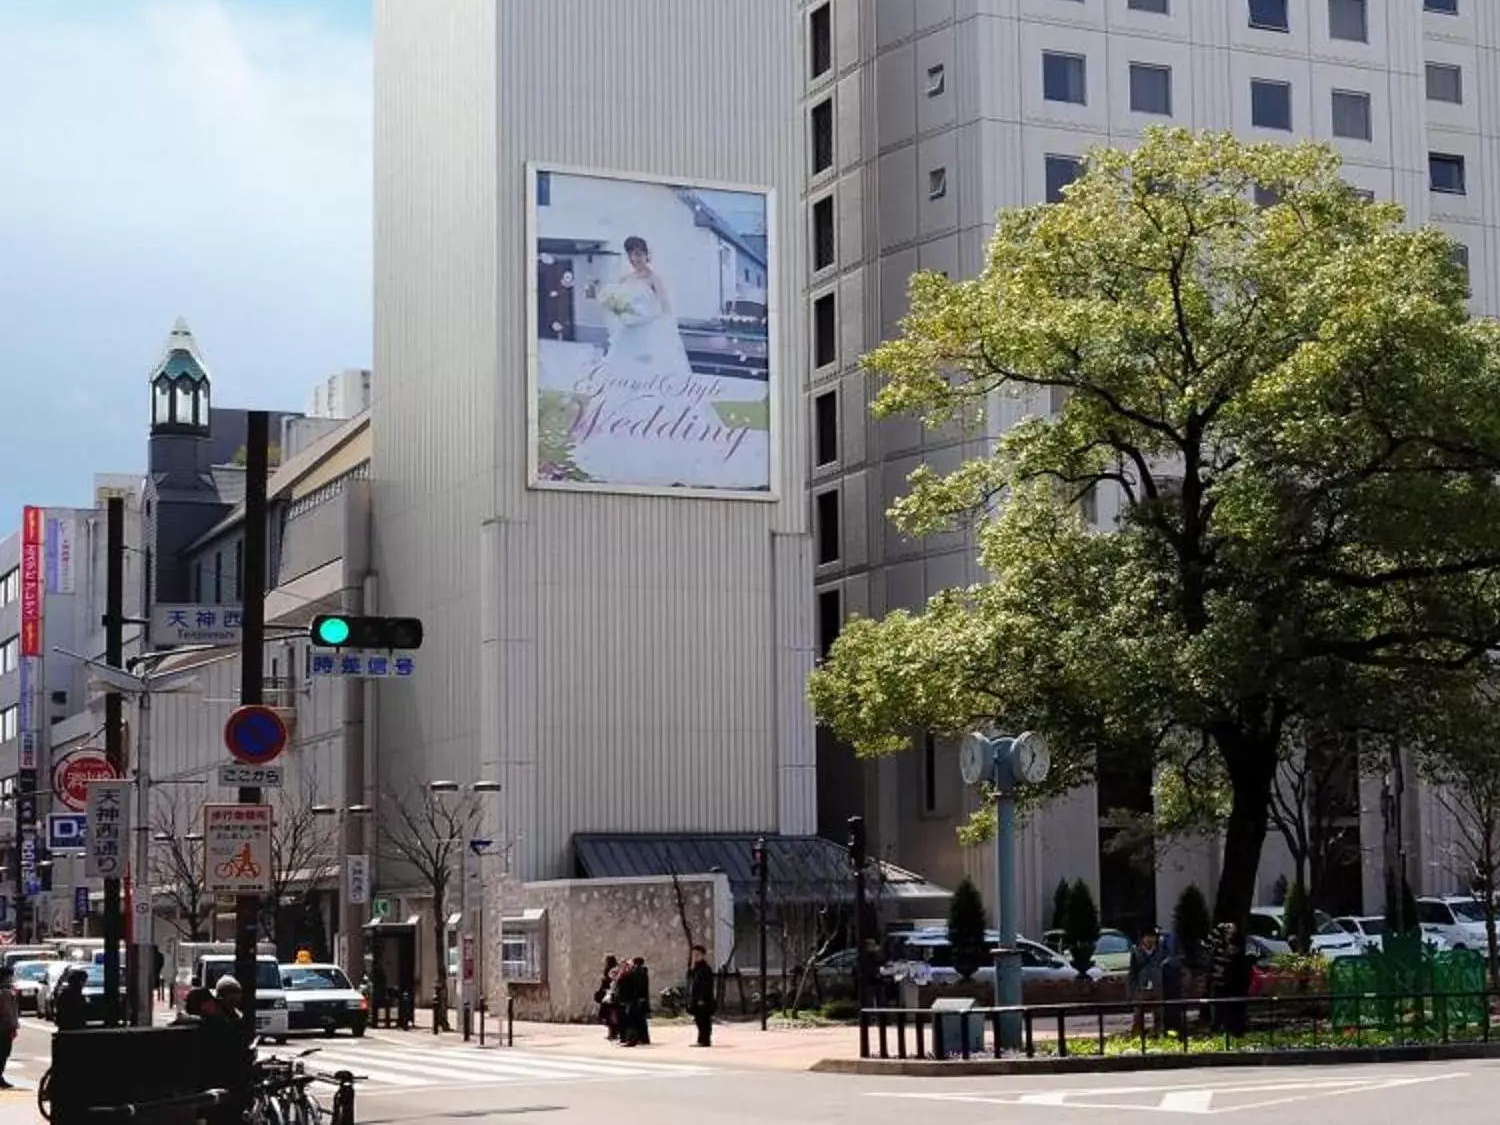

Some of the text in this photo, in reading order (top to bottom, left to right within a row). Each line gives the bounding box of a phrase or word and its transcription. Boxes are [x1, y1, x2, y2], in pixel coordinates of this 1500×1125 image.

[568, 394, 749, 463] Wedding
[166, 610, 243, 629] 天神西
[312, 654, 415, 675] 時差信号
[223, 769, 281, 785] ここから
[95, 788, 120, 873] 天神西通り
